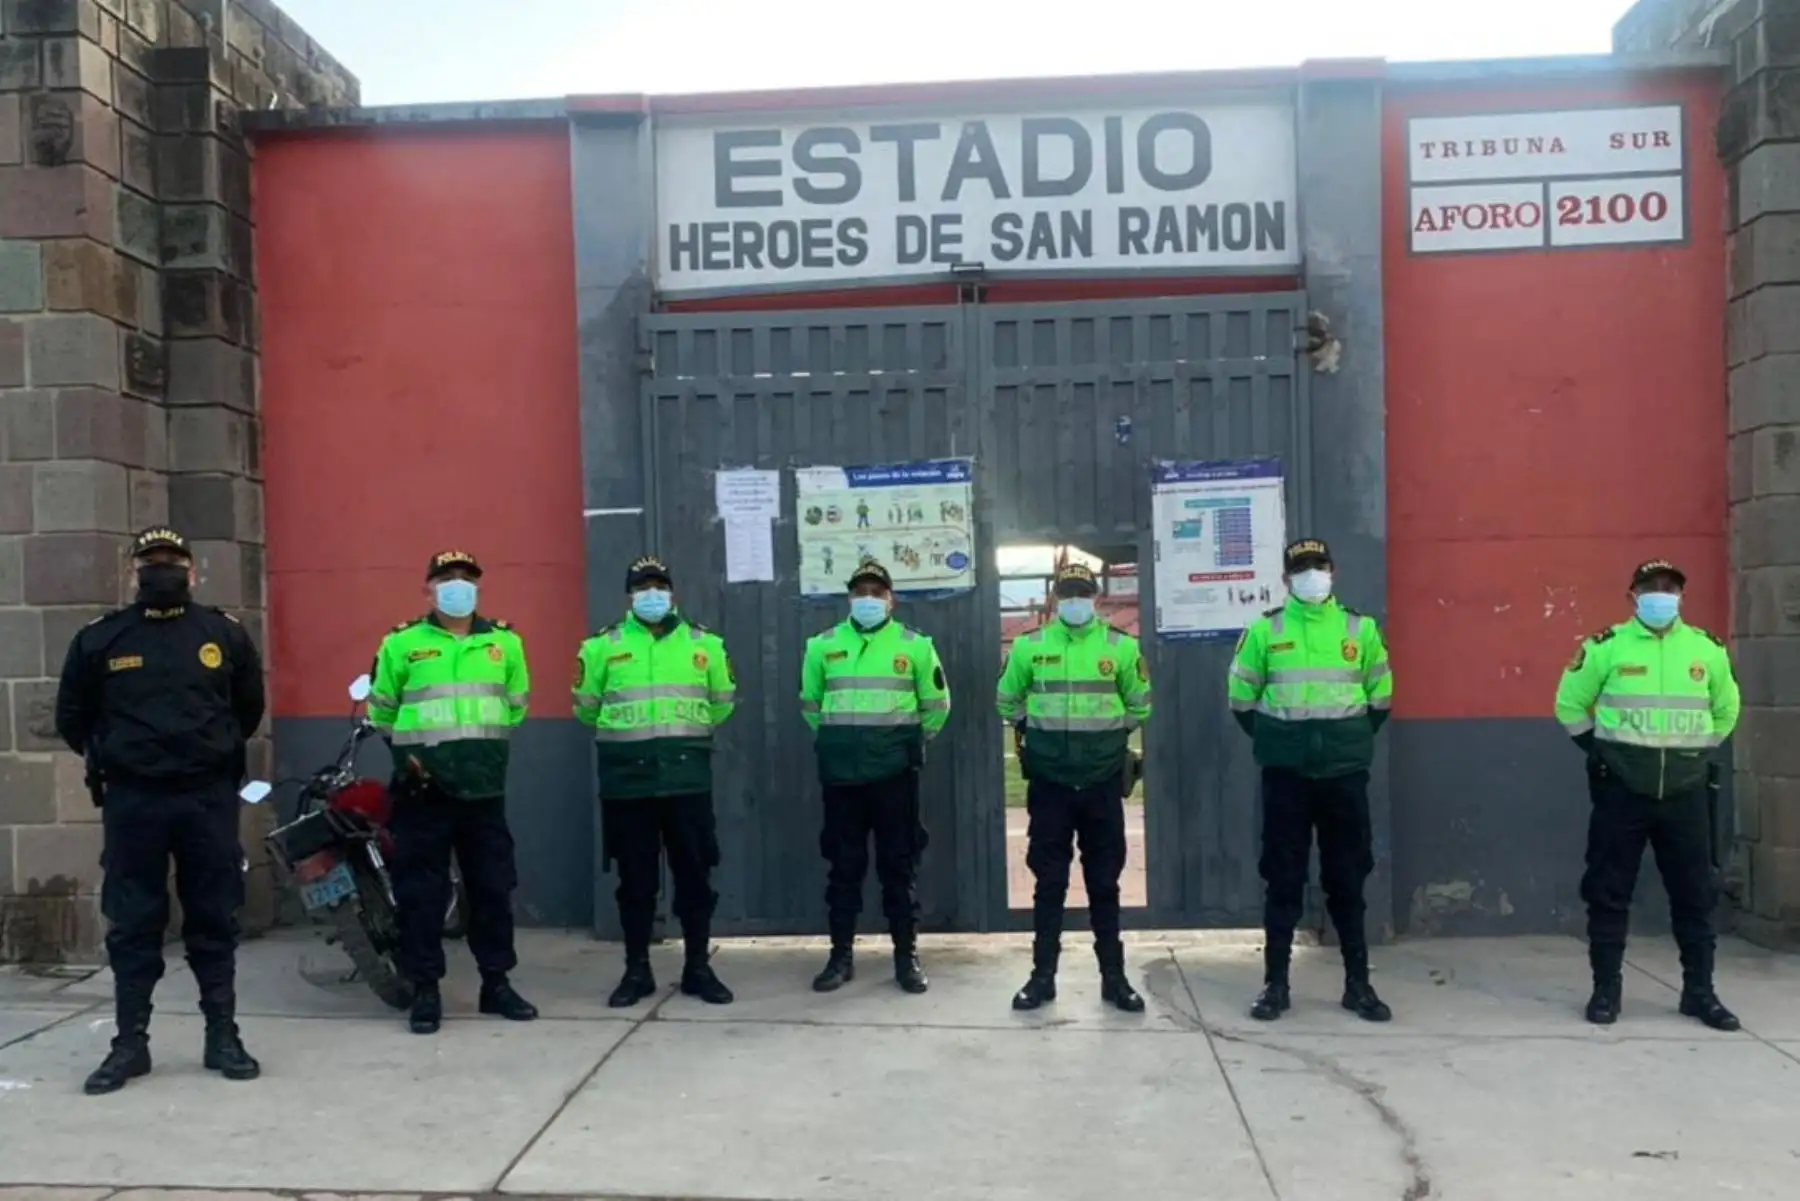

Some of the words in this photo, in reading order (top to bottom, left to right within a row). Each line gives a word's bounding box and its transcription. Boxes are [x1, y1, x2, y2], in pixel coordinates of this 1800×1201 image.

[714, 111, 1213, 208] ESTADIO
[1420, 137, 1566, 159] TRIBUNA
[1609, 131, 1672, 150] SUR
[1414, 202, 1541, 232] AFORO
[1556, 191, 1668, 225] 2100
[669, 217, 869, 271] HEROES
[896, 213, 963, 263] DE
[991, 209, 1093, 261] SAN
[1118, 201, 1286, 256] RAMON
